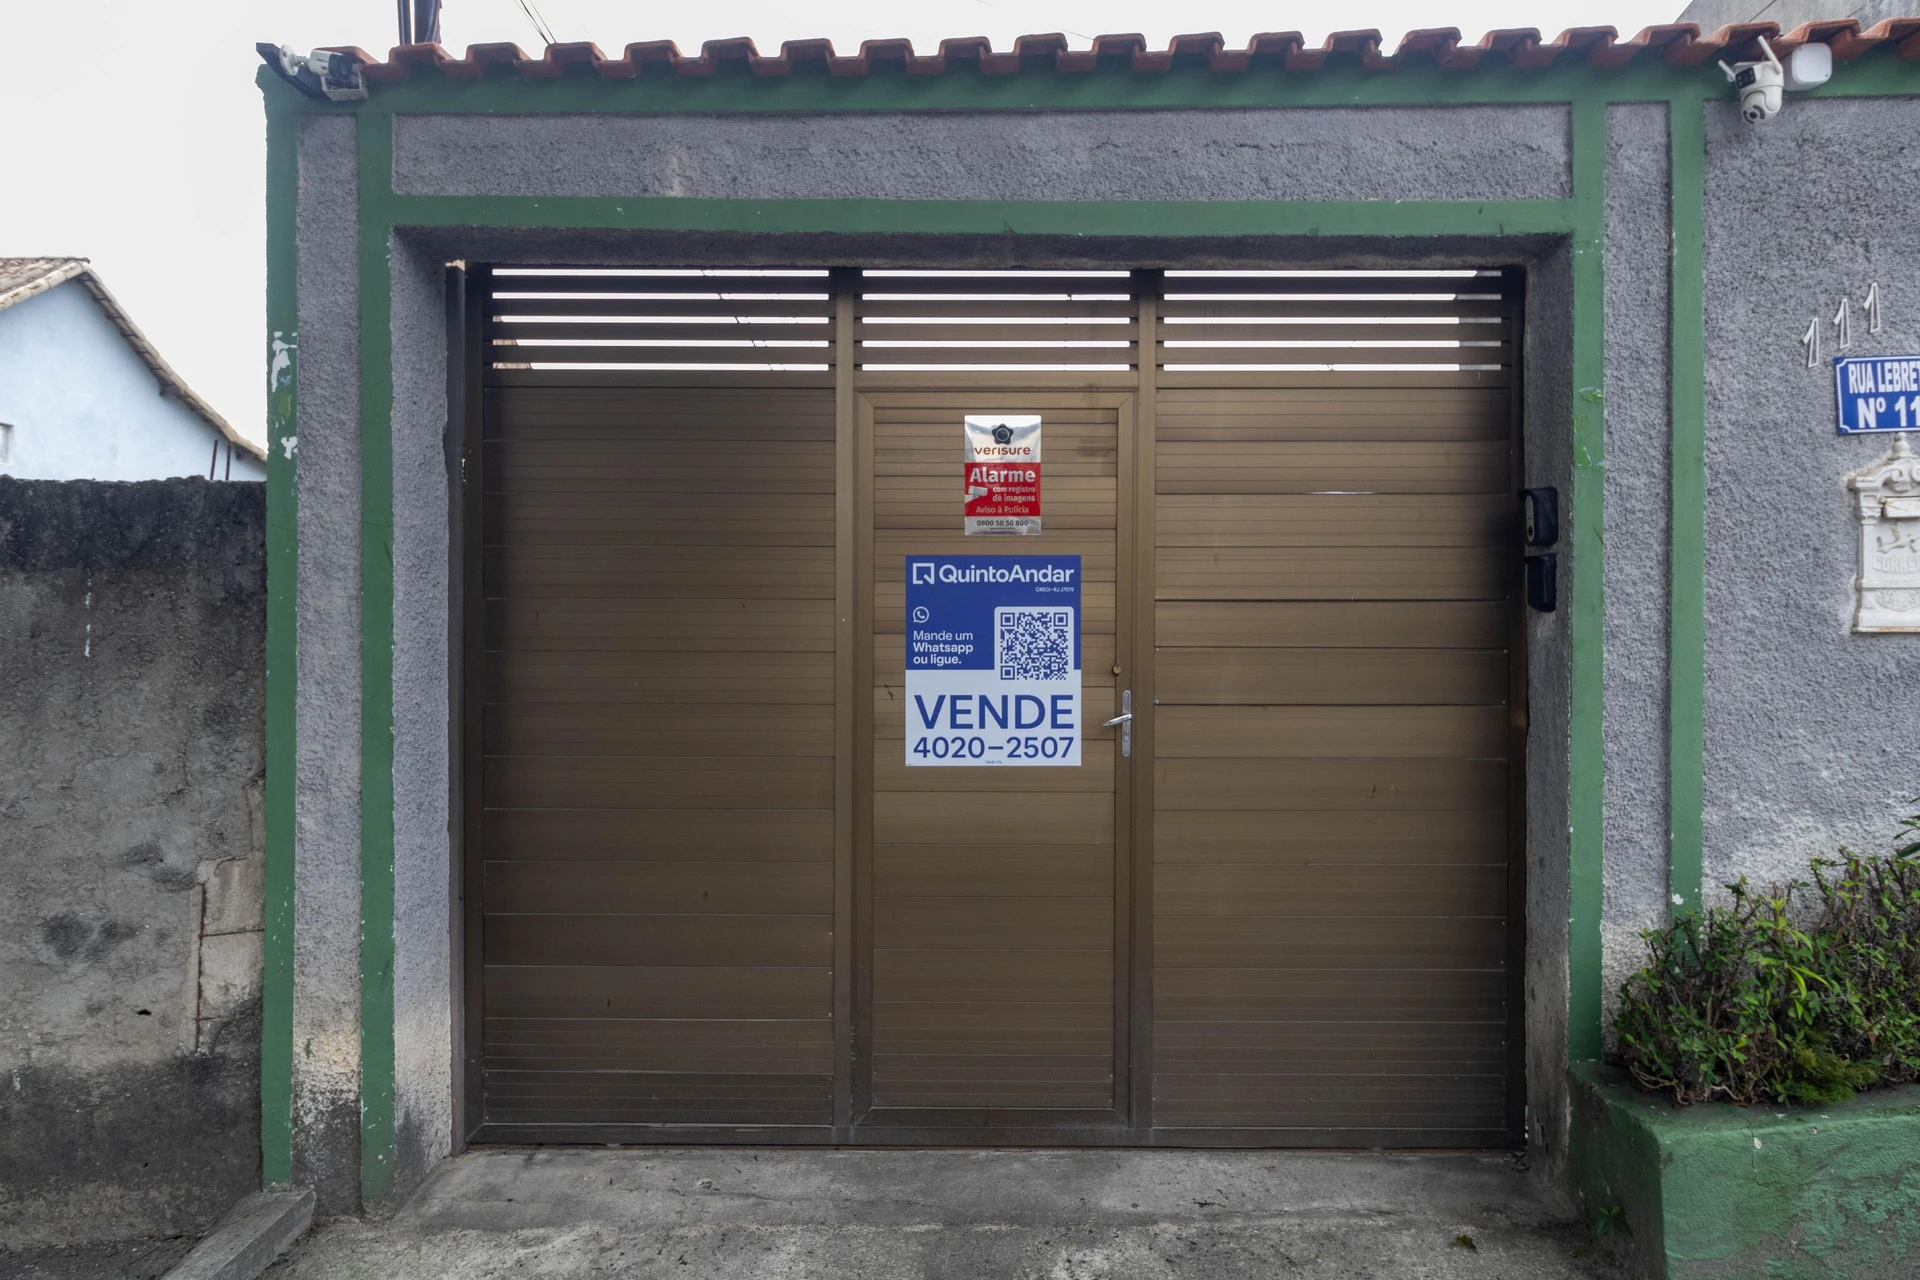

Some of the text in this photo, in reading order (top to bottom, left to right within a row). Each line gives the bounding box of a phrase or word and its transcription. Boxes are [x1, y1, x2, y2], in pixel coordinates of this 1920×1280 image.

[1848, 362, 1875, 394] RUA
[974, 446, 1031, 455] verisure
[969, 467, 1036, 483] Alarme
[1008, 485, 1036, 494] registro
[992, 494, 1035, 503] de imagens
[976, 506, 996, 514] Aviso
[939, 564, 1074, 584] QuintoAndar
[913, 630, 973, 641] Mande um
[913, 642, 974, 655] Whatsapp
[913, 654, 962, 666] ou ligue.
[913, 694, 1074, 729] VENDE
[913, 736, 1074, 759] 4020-2507
